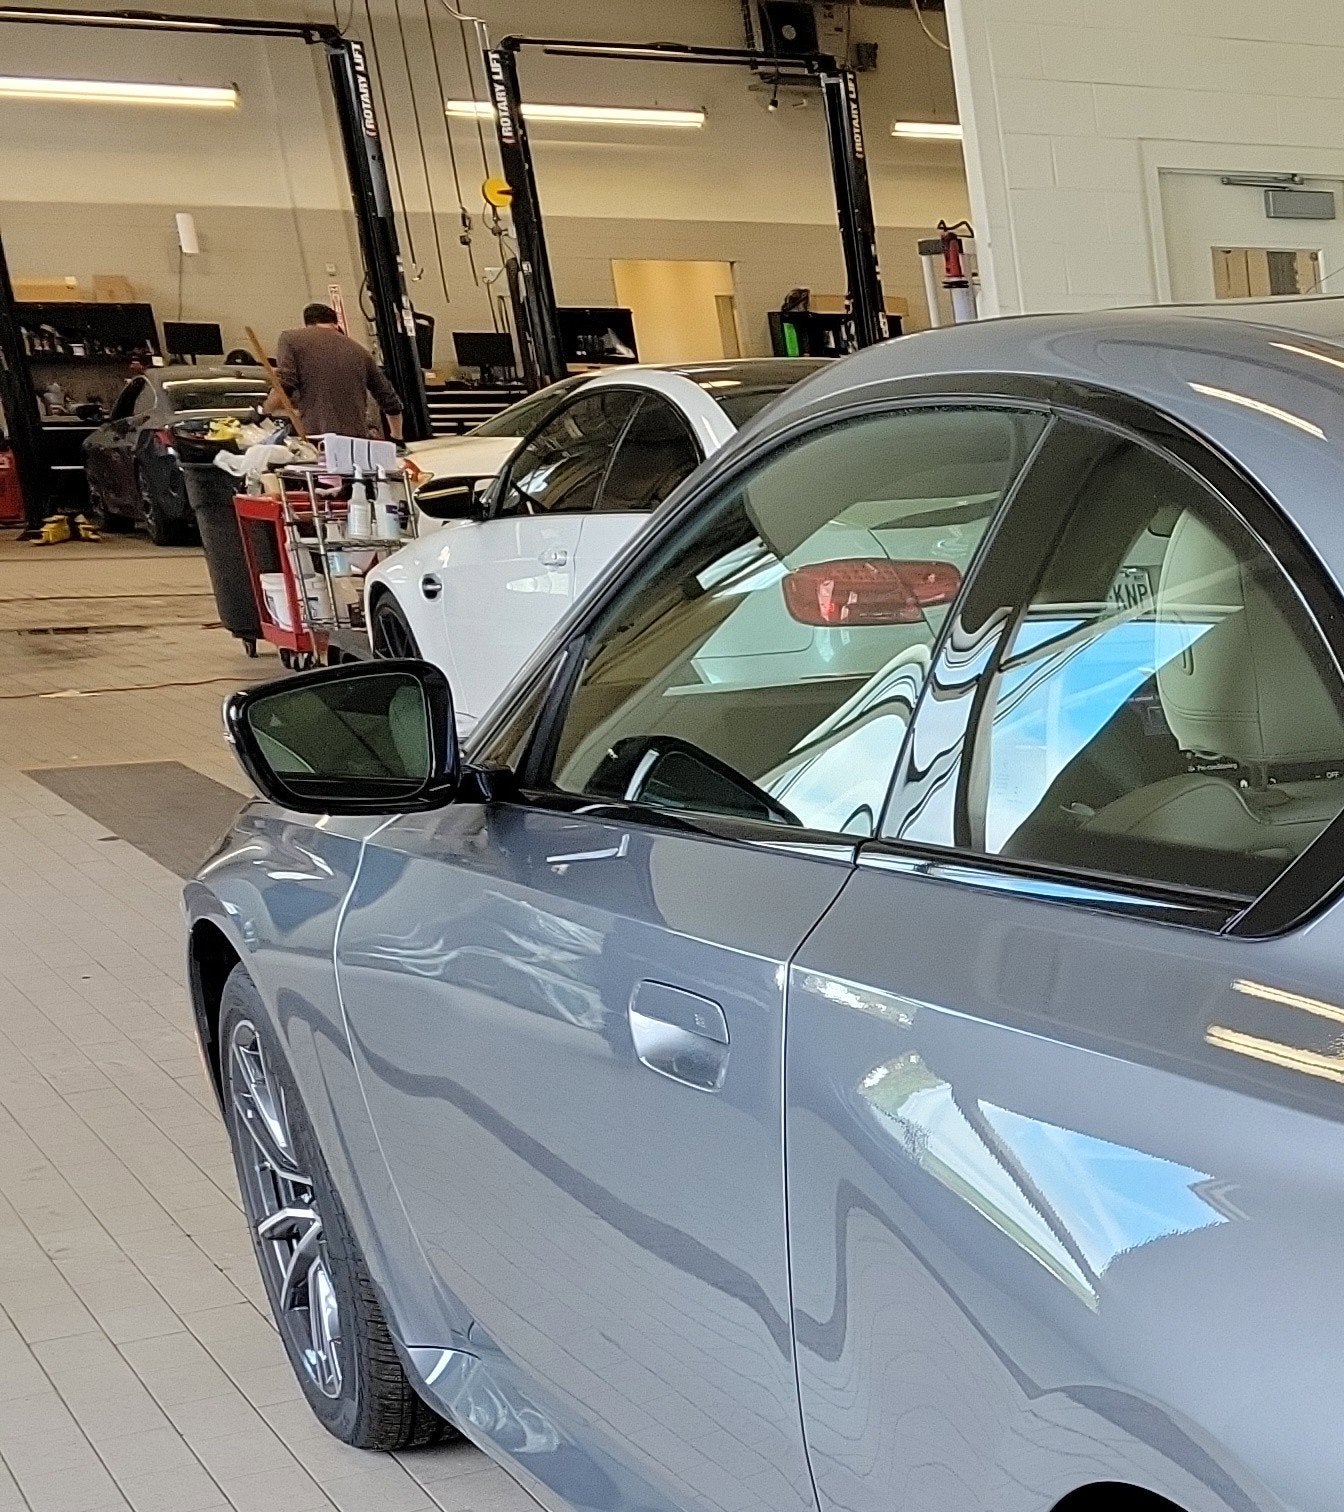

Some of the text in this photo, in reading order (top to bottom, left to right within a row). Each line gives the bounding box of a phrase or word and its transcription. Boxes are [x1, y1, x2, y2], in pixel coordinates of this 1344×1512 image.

[351, 41, 375, 129] ROTARY LIFT
[488, 51, 514, 136] ROTARY LIFT
